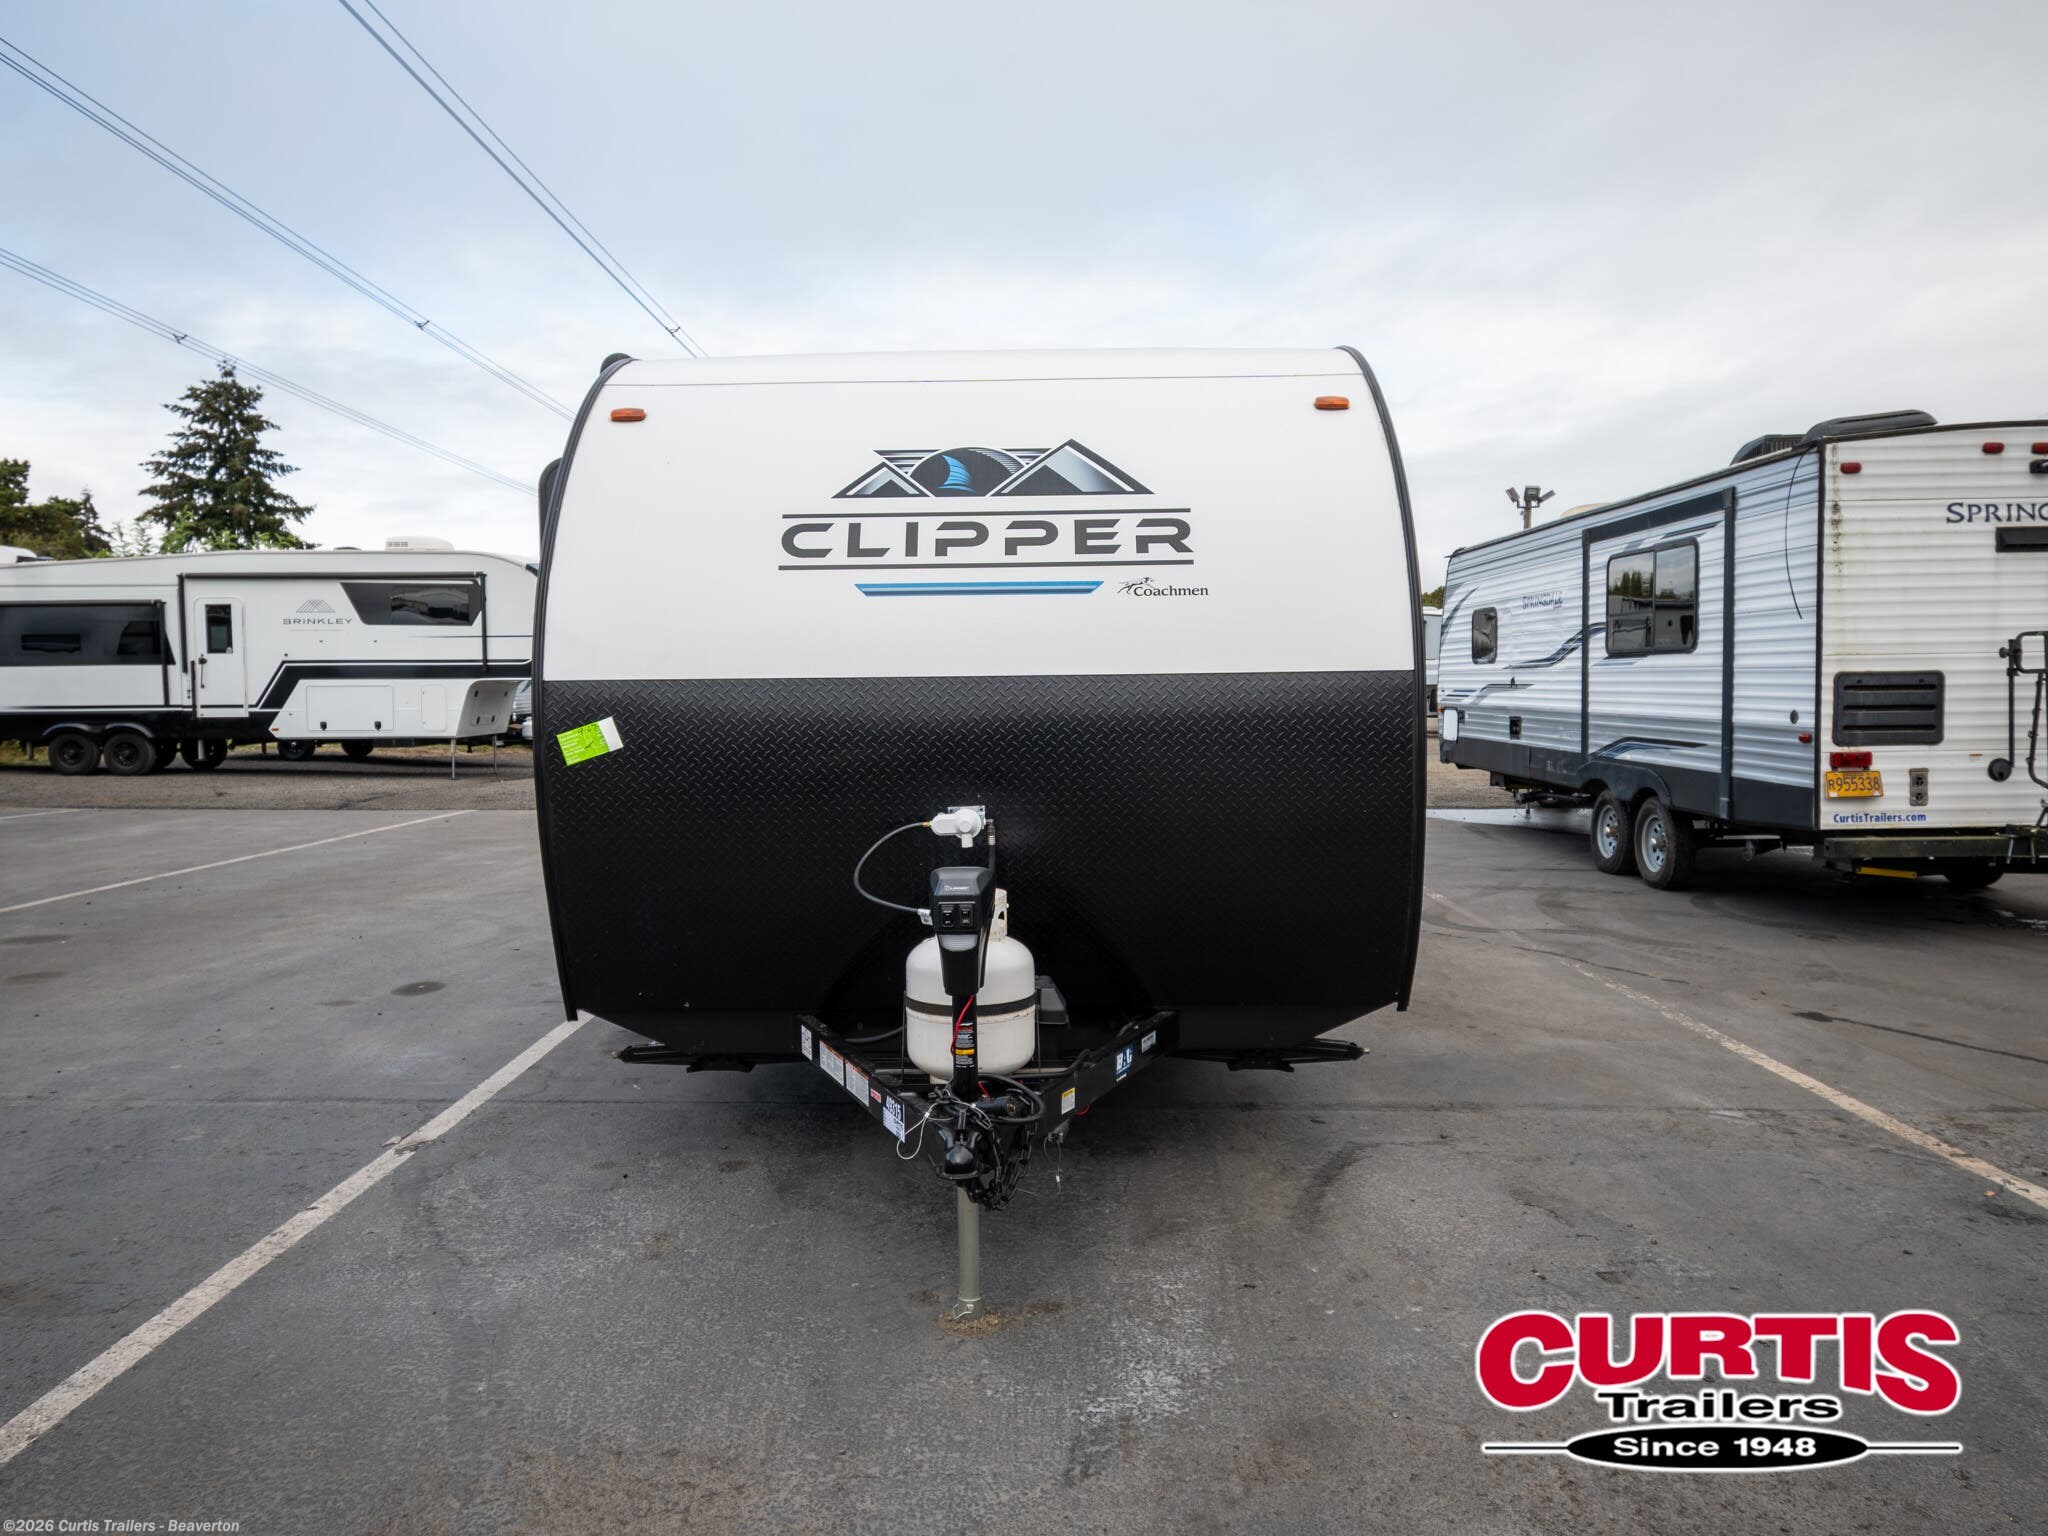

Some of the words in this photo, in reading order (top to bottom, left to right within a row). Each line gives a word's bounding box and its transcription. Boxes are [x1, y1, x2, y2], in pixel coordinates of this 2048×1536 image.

[781, 517, 1194, 559] CLIPPER
[1133, 585, 1209, 597] Coachmen
[1828, 776, 1881, 792] R955338
[1833, 812, 1927, 823] CurtisTrailers.com
